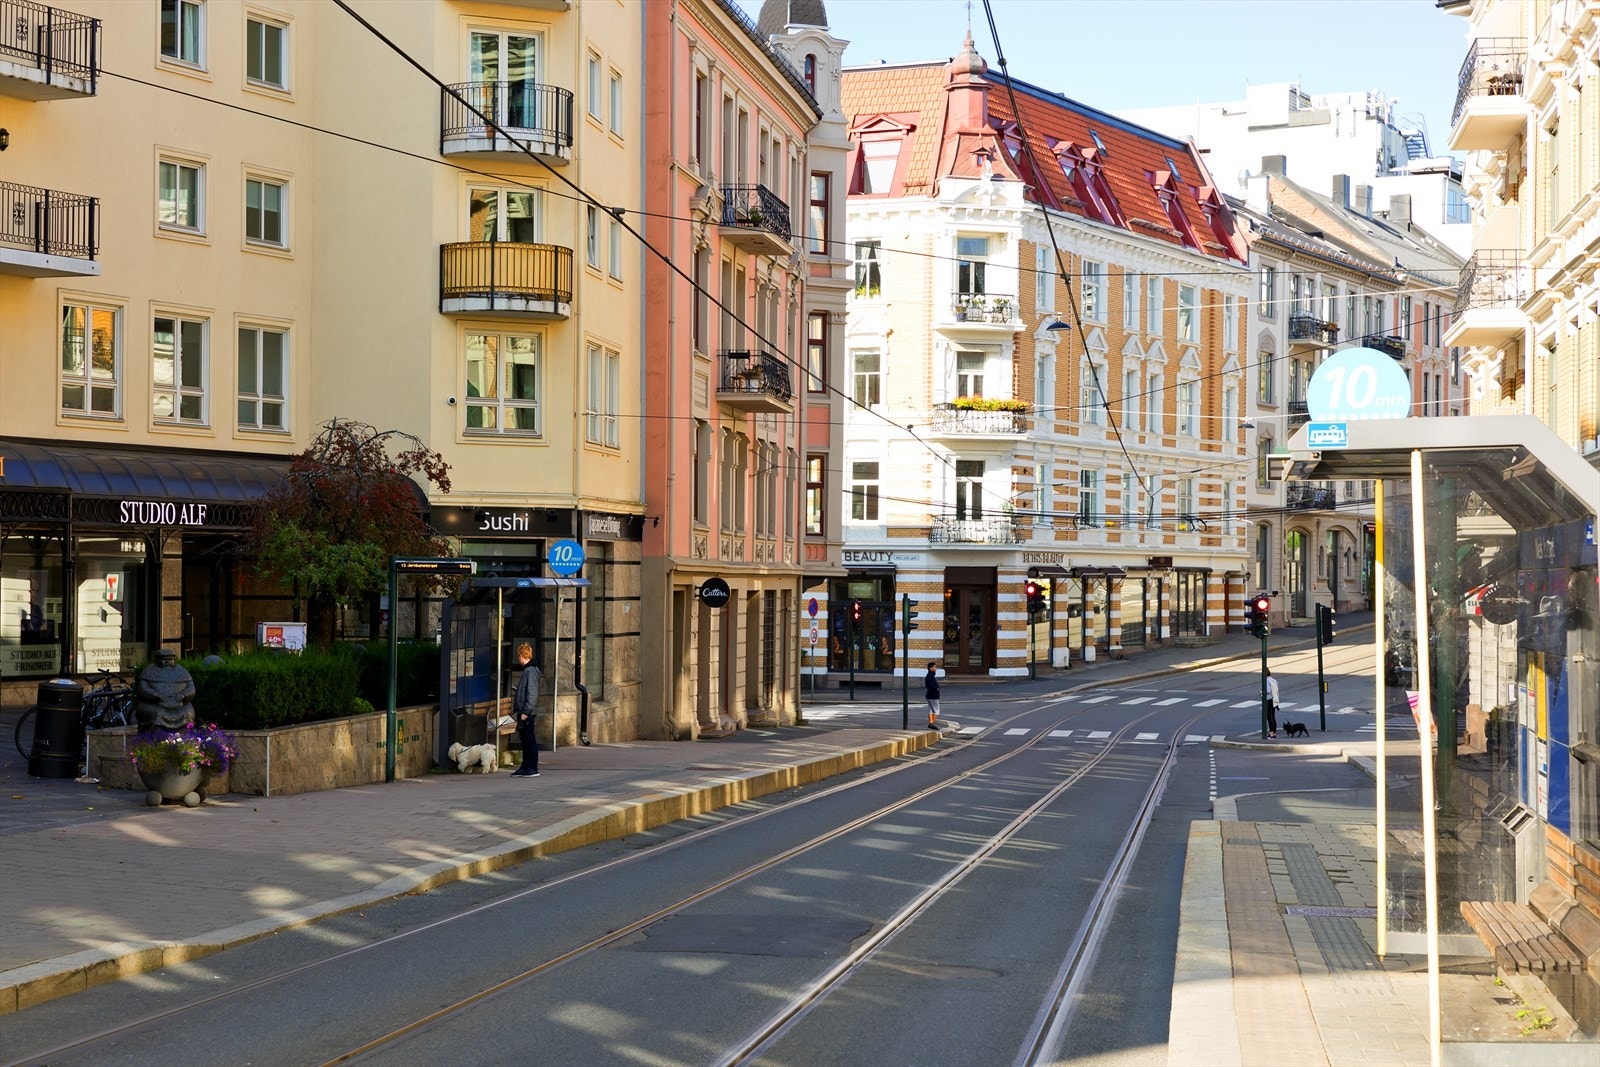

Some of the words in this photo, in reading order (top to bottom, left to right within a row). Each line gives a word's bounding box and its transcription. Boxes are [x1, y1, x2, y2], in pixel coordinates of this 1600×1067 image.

[1323, 365, 1377, 409] 10
[1375, 393, 1405, 407] min
[120, 500, 176, 525] STUDIO
[179, 504, 207, 526] ALF
[554, 545, 573, 562] 10
[844, 551, 893, 561] BEAUTY
[10, 650, 43, 660] STUDIO
[44, 650, 58, 659] ALF
[91, 648, 121, 657] STUDIO
